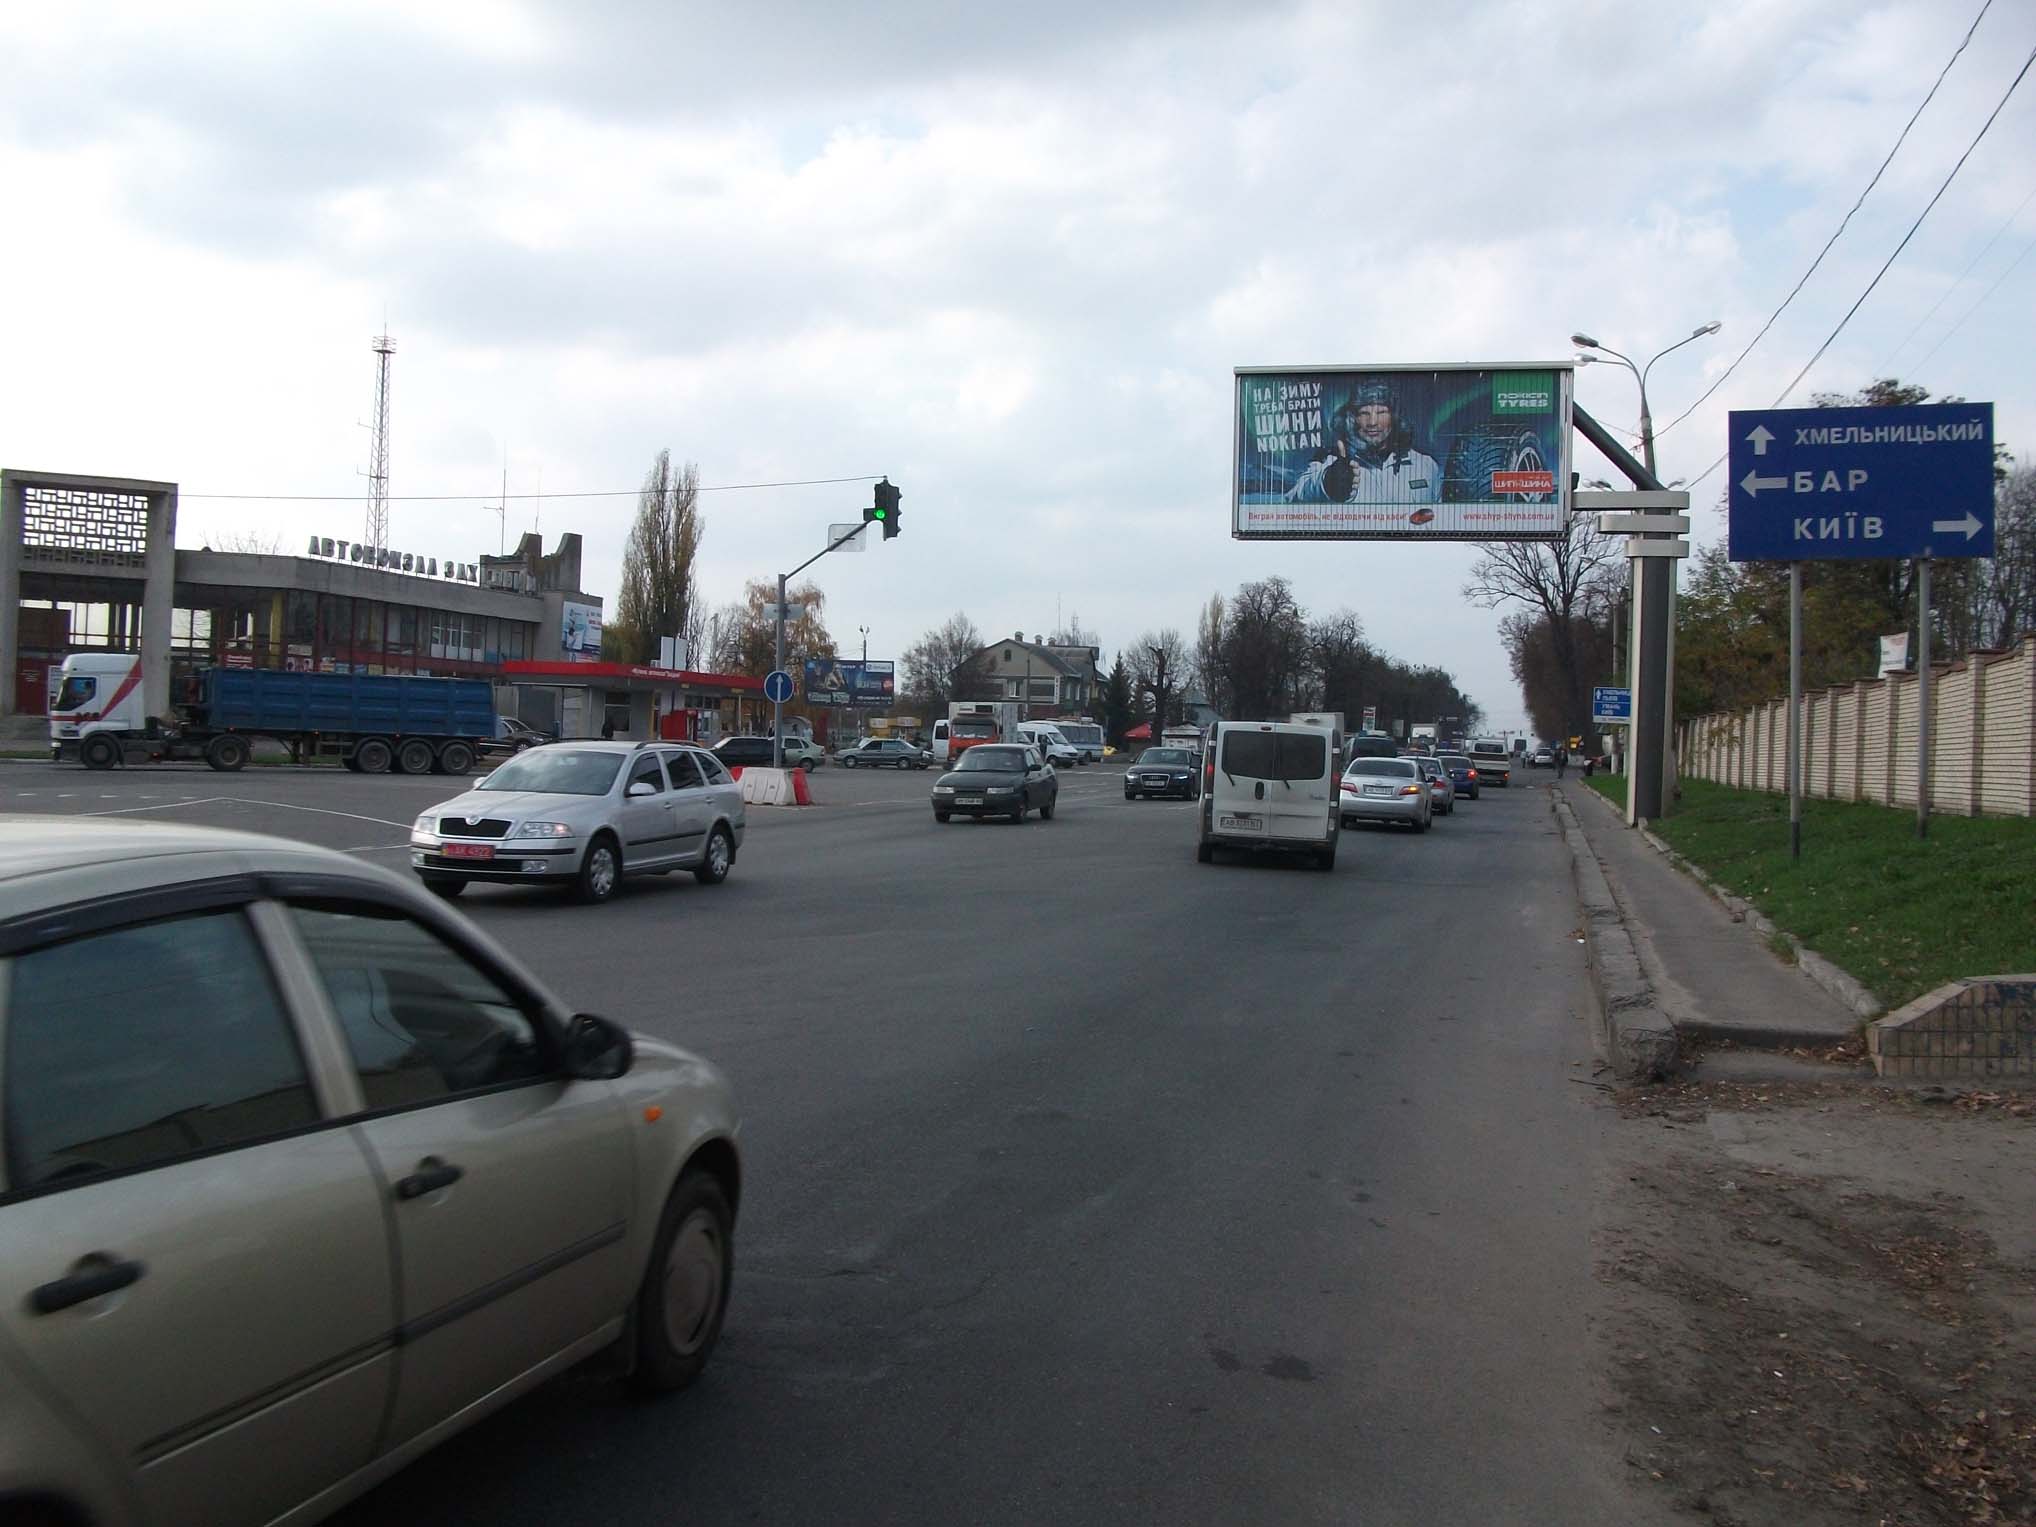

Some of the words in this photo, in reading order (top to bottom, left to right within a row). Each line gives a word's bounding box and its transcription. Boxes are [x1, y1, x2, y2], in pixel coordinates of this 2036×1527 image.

[1253, 387, 1272, 402] НА
[1280, 382, 1321, 400] ЗИМУ
[1497, 399, 1549, 408] TYRES
[1253, 401, 1285, 413] ТРЕБА
[1287, 398, 1321, 411] БРАТИ
[1254, 410, 1322, 435] ШИНИ
[1794, 418, 1984, 446] ХМЕЛЬНИЦЬКИЙ
[1256, 432, 1322, 452] NOKIAN
[1794, 469, 1869, 493] БАР
[1794, 511, 1885, 540] КИЇВ
[307, 535, 438, 576] АВТОВОКЗАЛ
